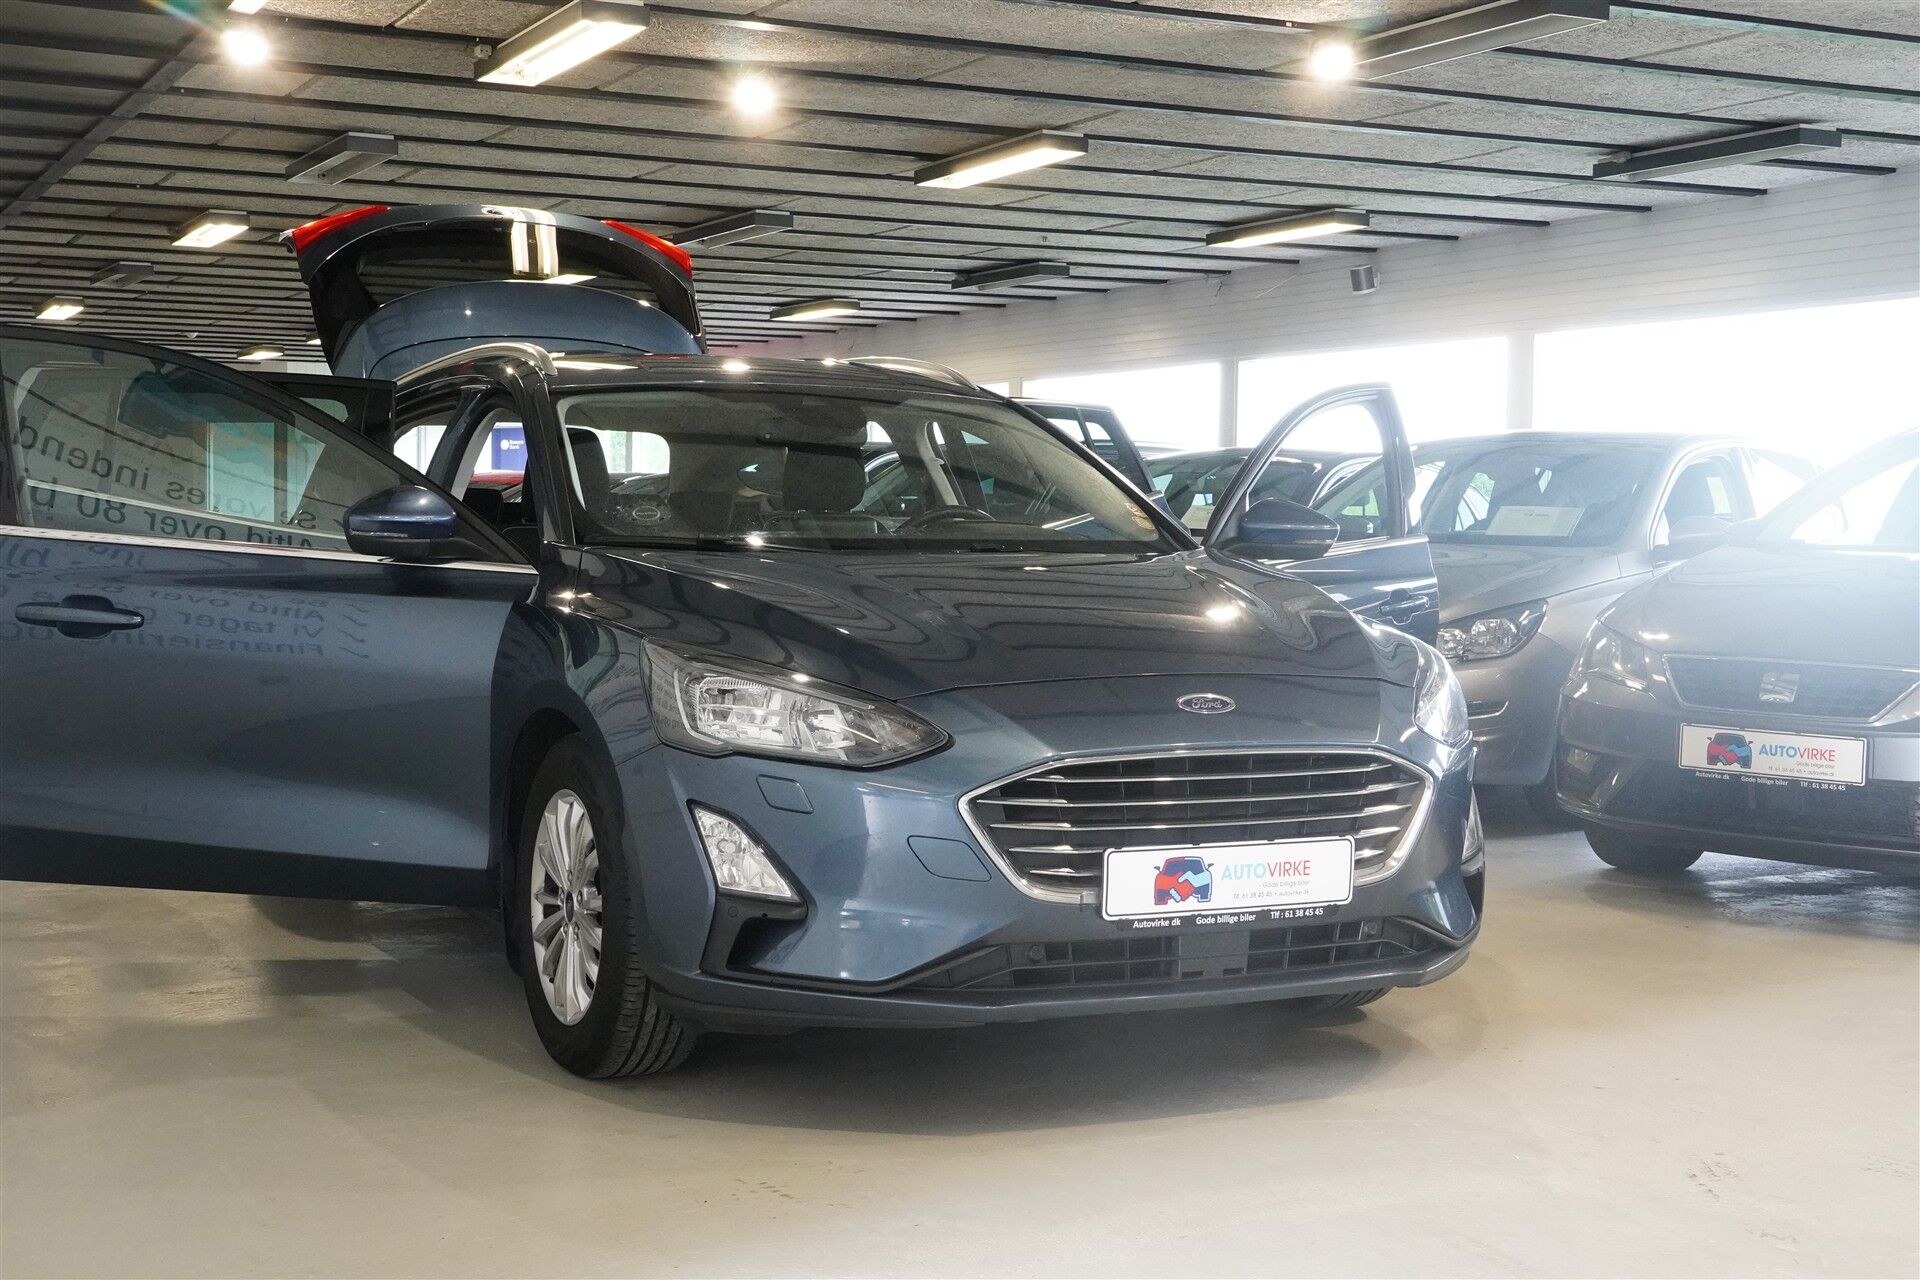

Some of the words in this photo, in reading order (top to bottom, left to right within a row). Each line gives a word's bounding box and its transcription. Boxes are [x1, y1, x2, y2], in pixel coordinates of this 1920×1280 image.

[1191, 698, 1223, 709] Ford
[1759, 743, 1836, 762] AUTOVIRKE
[1695, 771, 1721, 779] Autovirke
[1757, 777, 1774, 785] billige
[1221, 860, 1311, 880] AUTOVIRKE
[1284, 909, 1294, 918] 61
[1294, 908, 1304, 918] 38
[1304, 908, 1314, 917] 45
[1314, 907, 1324, 916] 45
[1133, 919, 1170, 928] Autovirke
[1195, 916, 1216, 925] Gode
[1217, 914, 1239, 924] billige
[1239, 913, 1256, 922] biler
